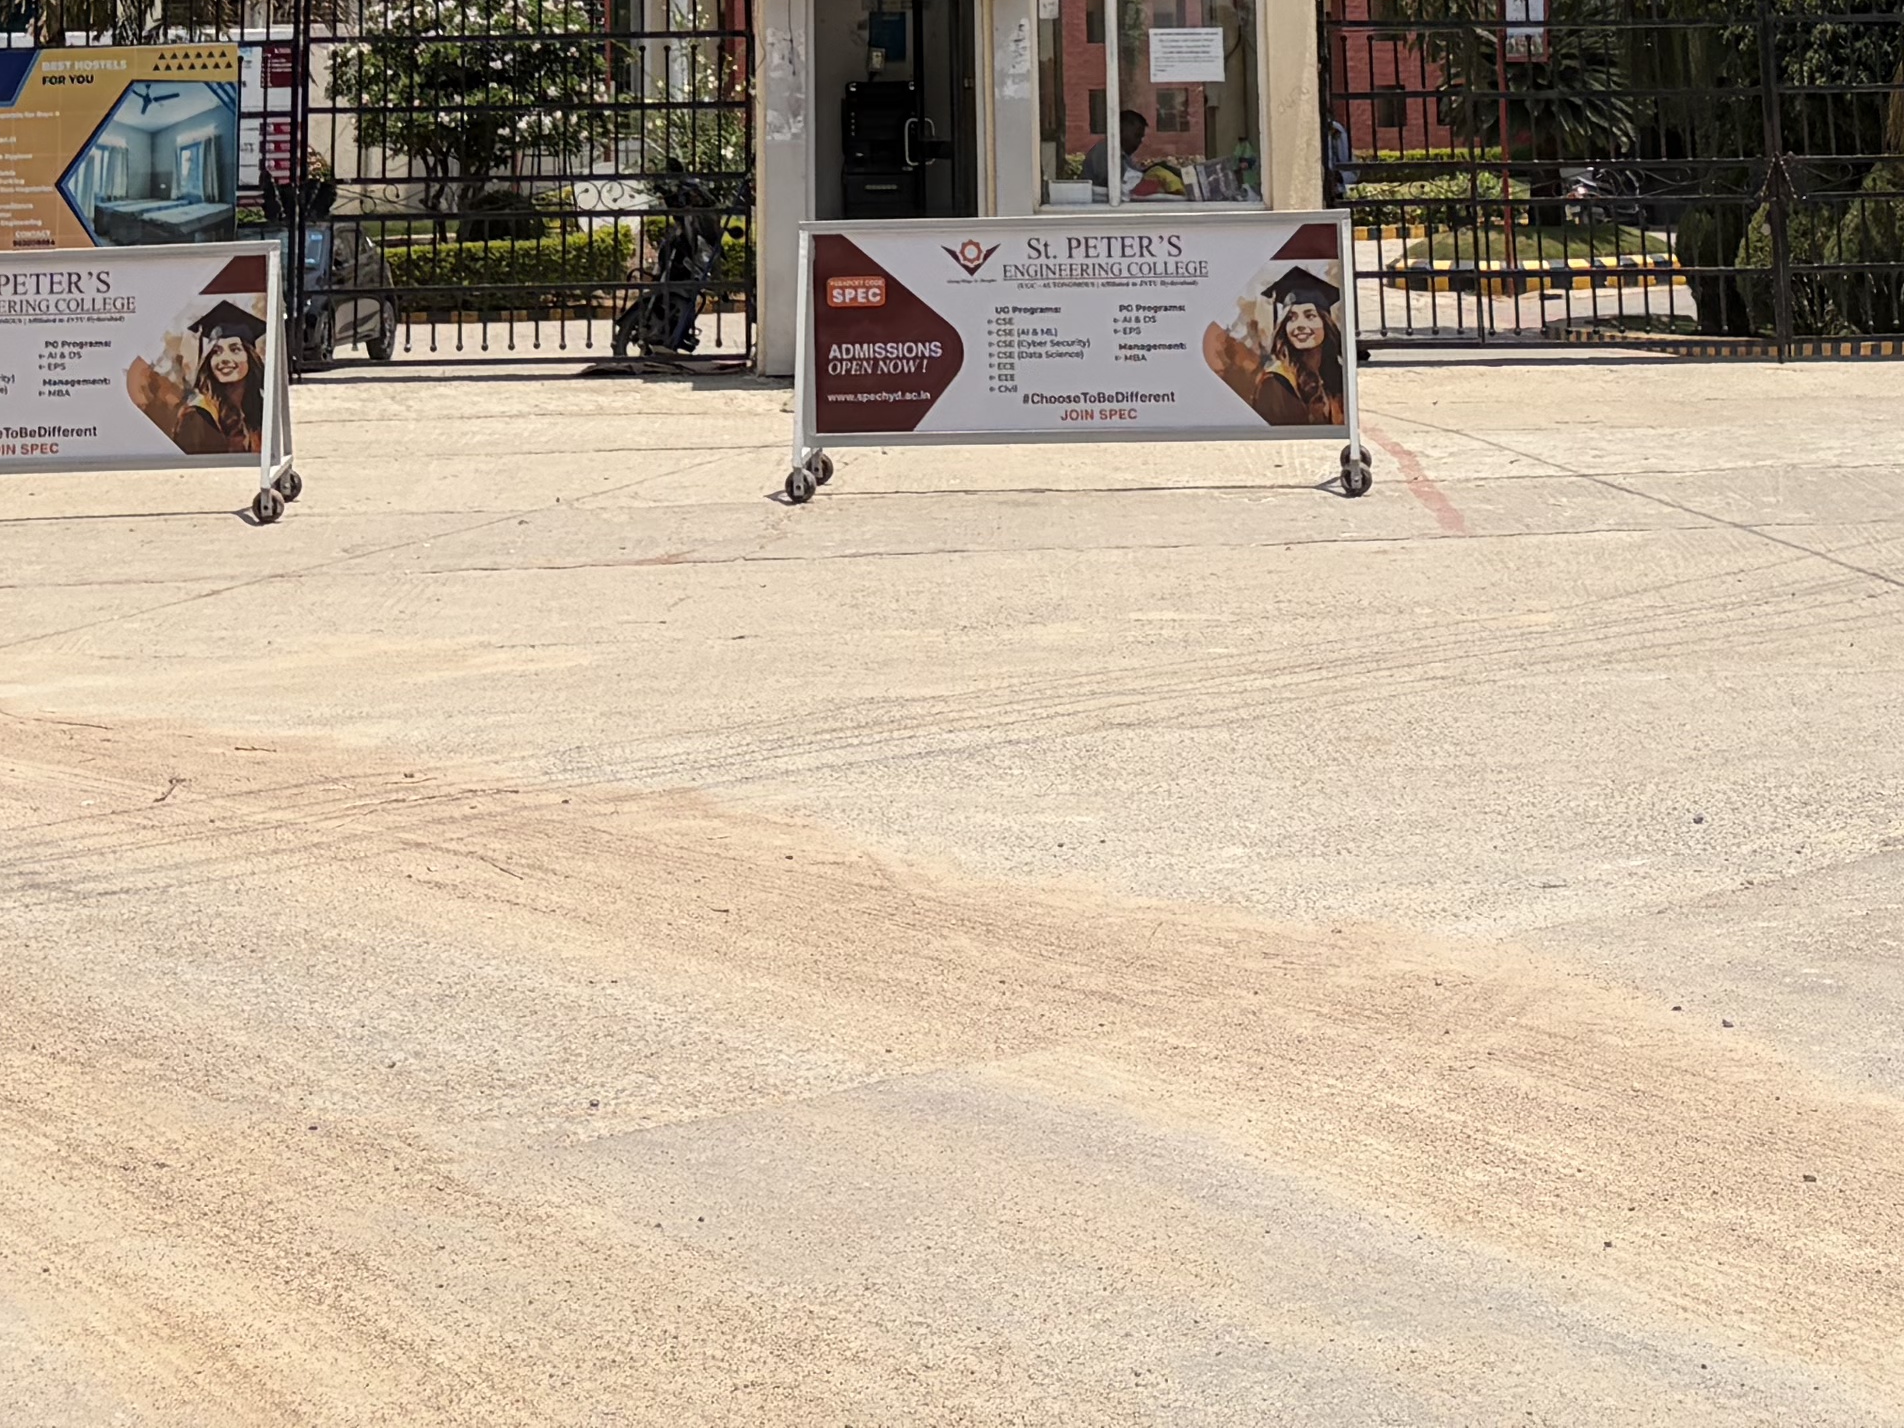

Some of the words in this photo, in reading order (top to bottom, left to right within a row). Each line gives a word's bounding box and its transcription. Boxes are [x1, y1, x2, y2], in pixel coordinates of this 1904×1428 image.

[42, 61, 71, 71] BEST
[75, 60, 127, 71] HOSTELS
[42, 76, 65, 85] FOR
[70, 75, 94, 84] YOU
[1027, 237, 1056, 260] St.
[1067, 235, 1182, 259] PETER'S
[1003, 262, 1122, 279] ENGINEERING
[1127, 260, 1208, 276] COLLEGE
[832, 288, 881, 303] SPEC
[55, 296, 136, 313] COLLEGE
[828, 341, 943, 359] ADMISSIONS
[996, 340, 1014, 348] CSE
[997, 351, 1015, 359] CSE
[828, 360, 874, 375] OPEN
[877, 359, 920, 375] NOW
[1022, 391, 1175, 404] #ChooseToBeDifferent
[1061, 409, 1094, 421] JOIN
[1099, 408, 1137, 419] SPEC
[21, 443, 59, 455] SPEC
